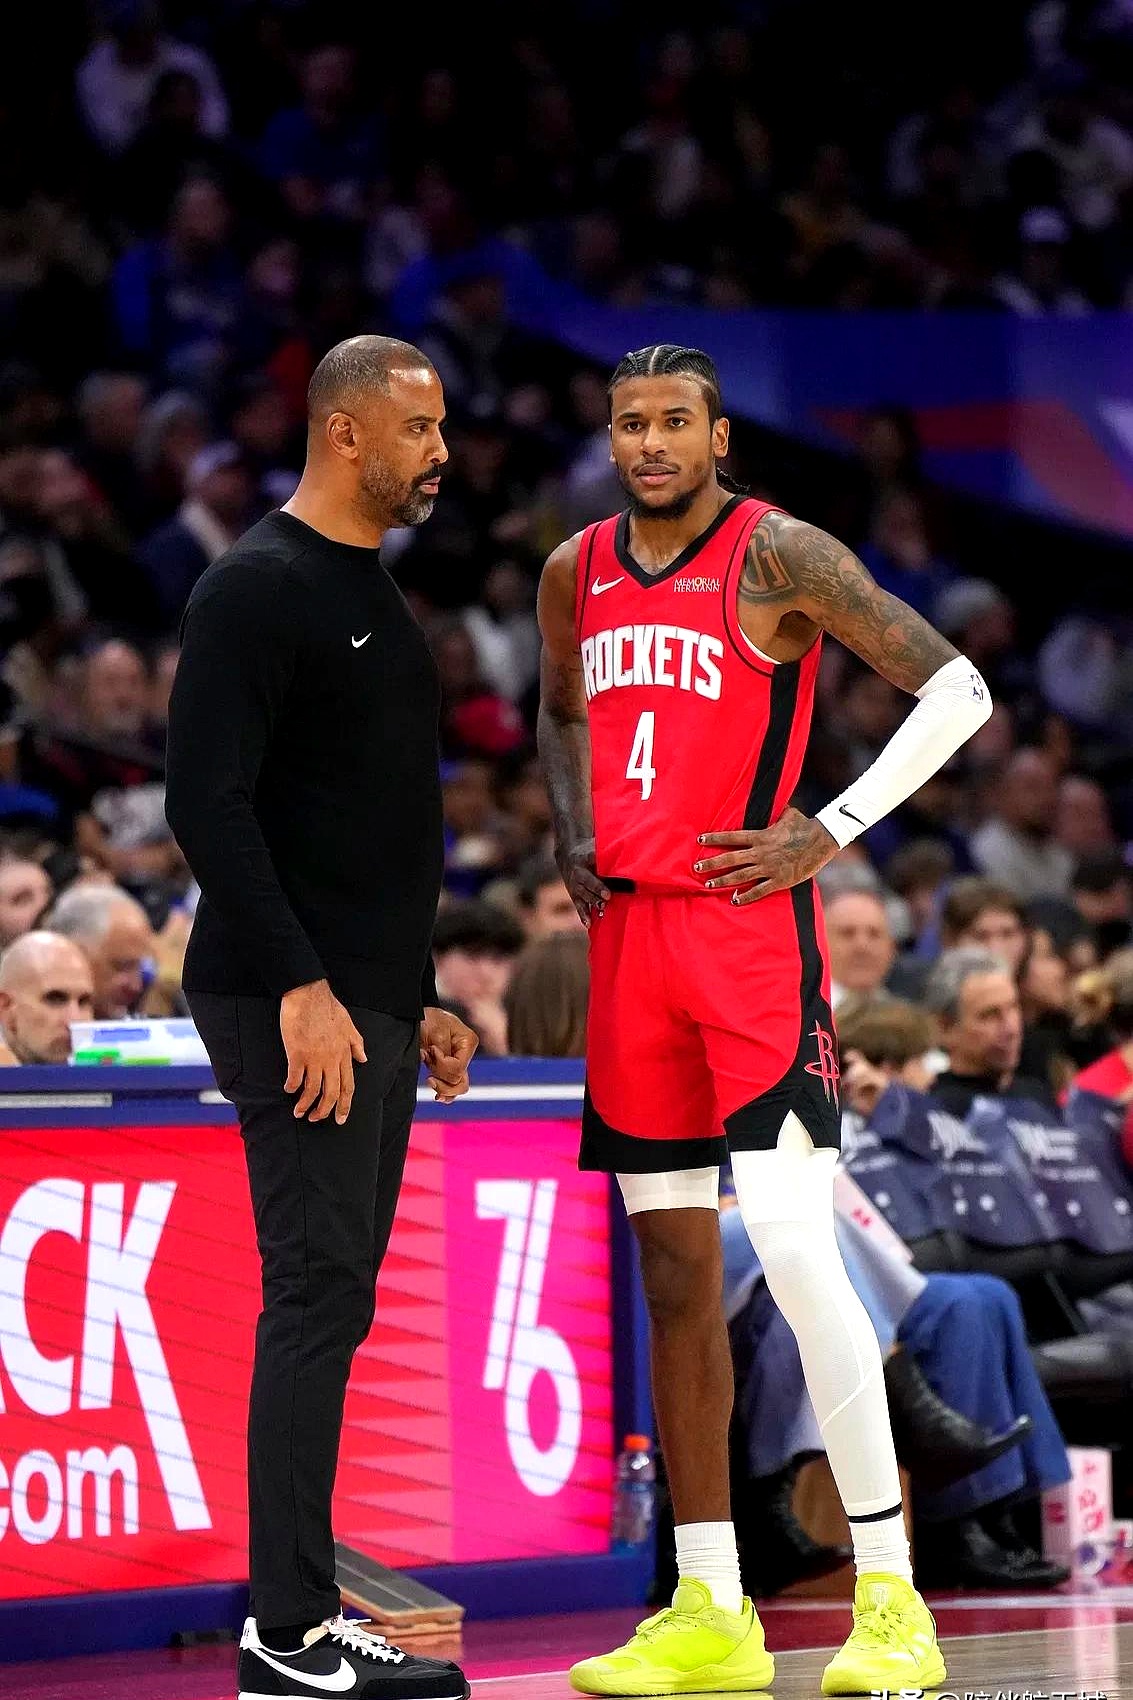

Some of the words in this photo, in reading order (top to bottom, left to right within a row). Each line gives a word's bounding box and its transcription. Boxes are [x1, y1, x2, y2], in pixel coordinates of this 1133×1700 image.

[673, 576, 721, 587] MEMORIAL
[673, 584, 721, 593] HERMANN
[581, 624, 724, 703] ROCKETS
[625, 711, 656, 801] 4
[0, 1177, 213, 1531] CK
[475, 1178, 583, 1497] 76
